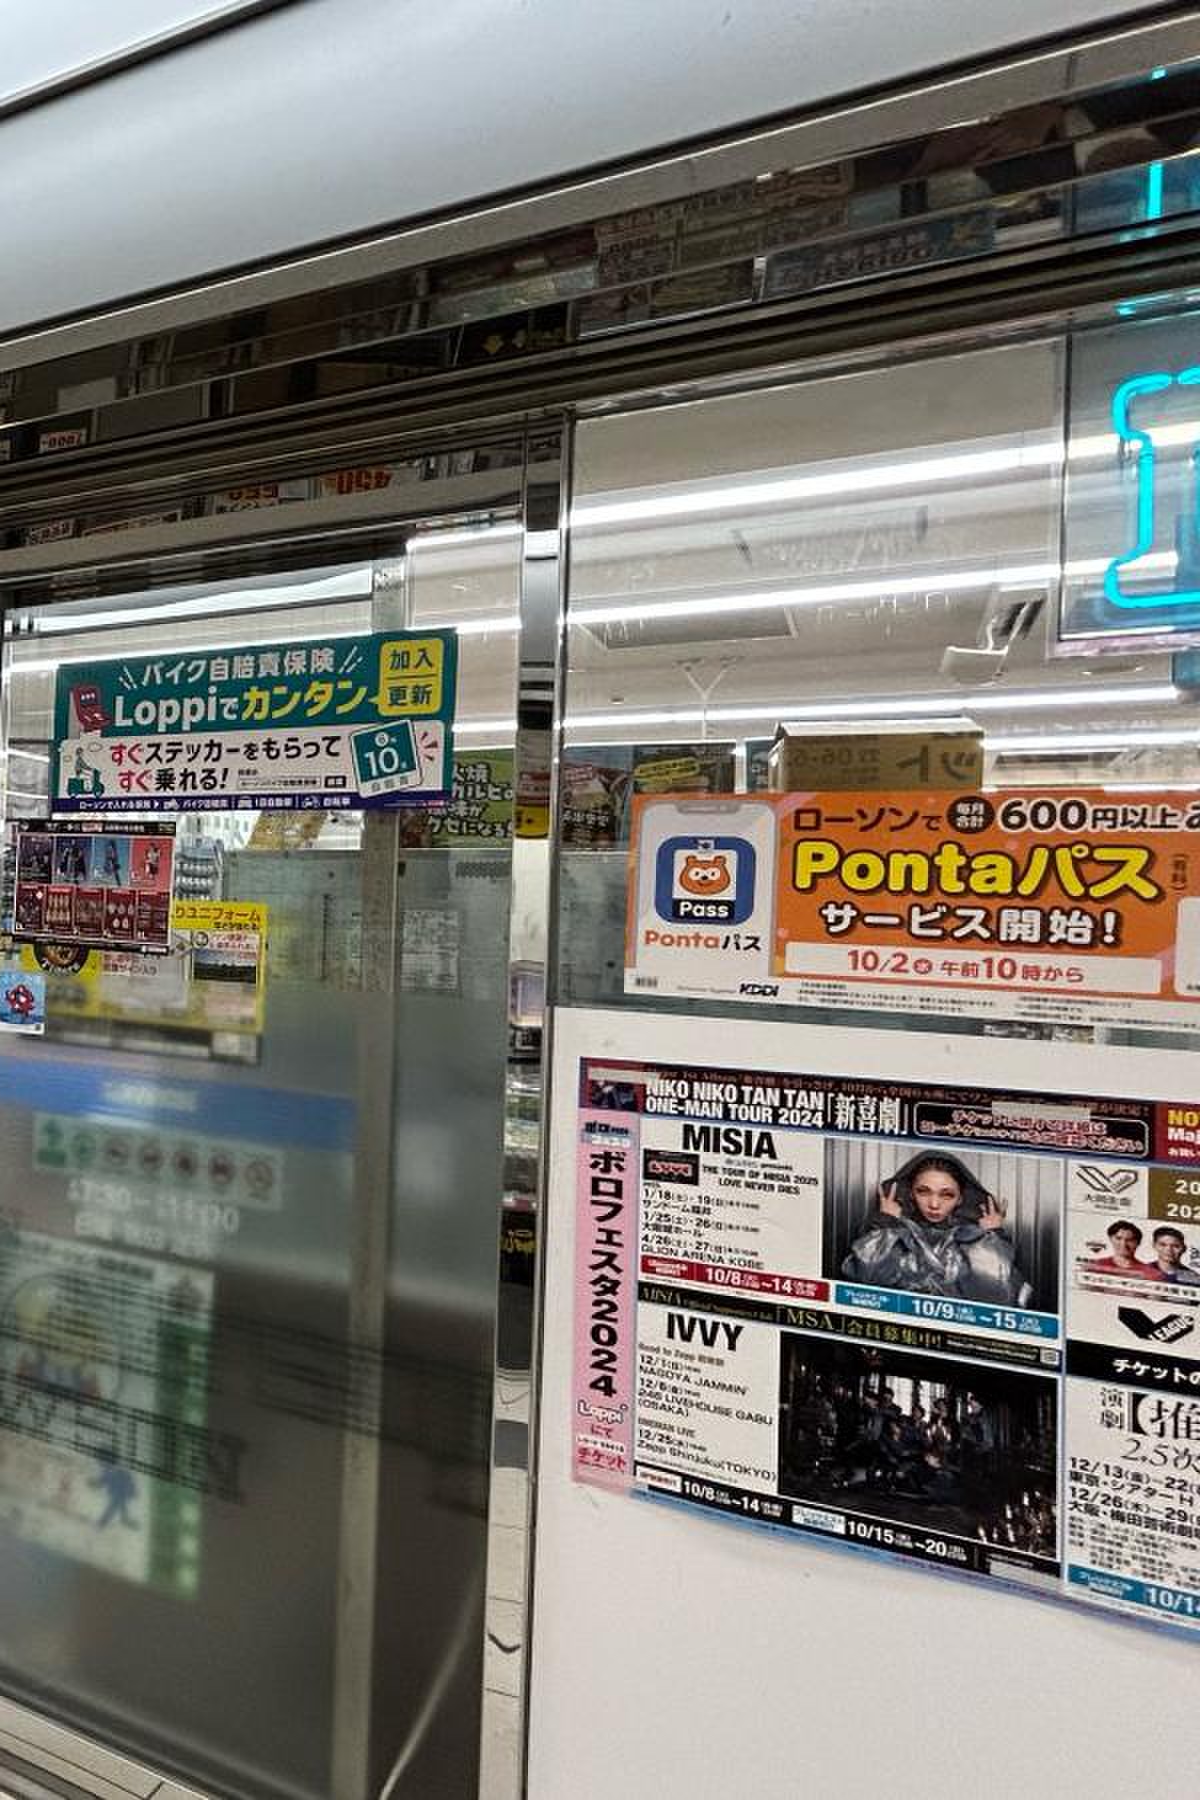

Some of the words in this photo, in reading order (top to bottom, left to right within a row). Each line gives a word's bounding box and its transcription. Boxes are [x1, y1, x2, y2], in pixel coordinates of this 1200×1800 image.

[141, 647, 336, 687] バイク自賠責保険
[389, 647, 434, 671] 加入
[114, 680, 368, 733] Loppiでカンタン
[388, 683, 434, 707] 更新
[110, 735, 342, 766] すぐステッカーをもらって
[364, 746, 400, 777] 10
[793, 807, 942, 832] ローソンで
[794, 839, 1162, 900] Pontaパス
[679, 901, 729, 918] Pass
[821, 902, 1117, 945] サービス開始!
[644, 929, 762, 951] Pontaパス
[739, 983, 780, 997] KDDI
[647, 1078, 689, 1099] NIKO
[692, 1082, 738, 1102] NIKO
[742, 1085, 781, 1106] TAN
[783, 1089, 825, 1110] TAN
[645, 1096, 723, 1120] ONE-MAN
[729, 1103, 776, 1124] TOUR
[779, 1107, 825, 1129] 2024
[682, 1124, 778, 1160] MISIA
[588, 1151, 626, 1398] ボロフェスタ2024
[705, 1267, 741, 1286] 10/8
[912, 1299, 955, 1319] 10/9
[666, 1311, 745, 1353] IVVY
[684, 1480, 715, 1500] 10/8
[848, 1520, 894, 1545] 10/15
